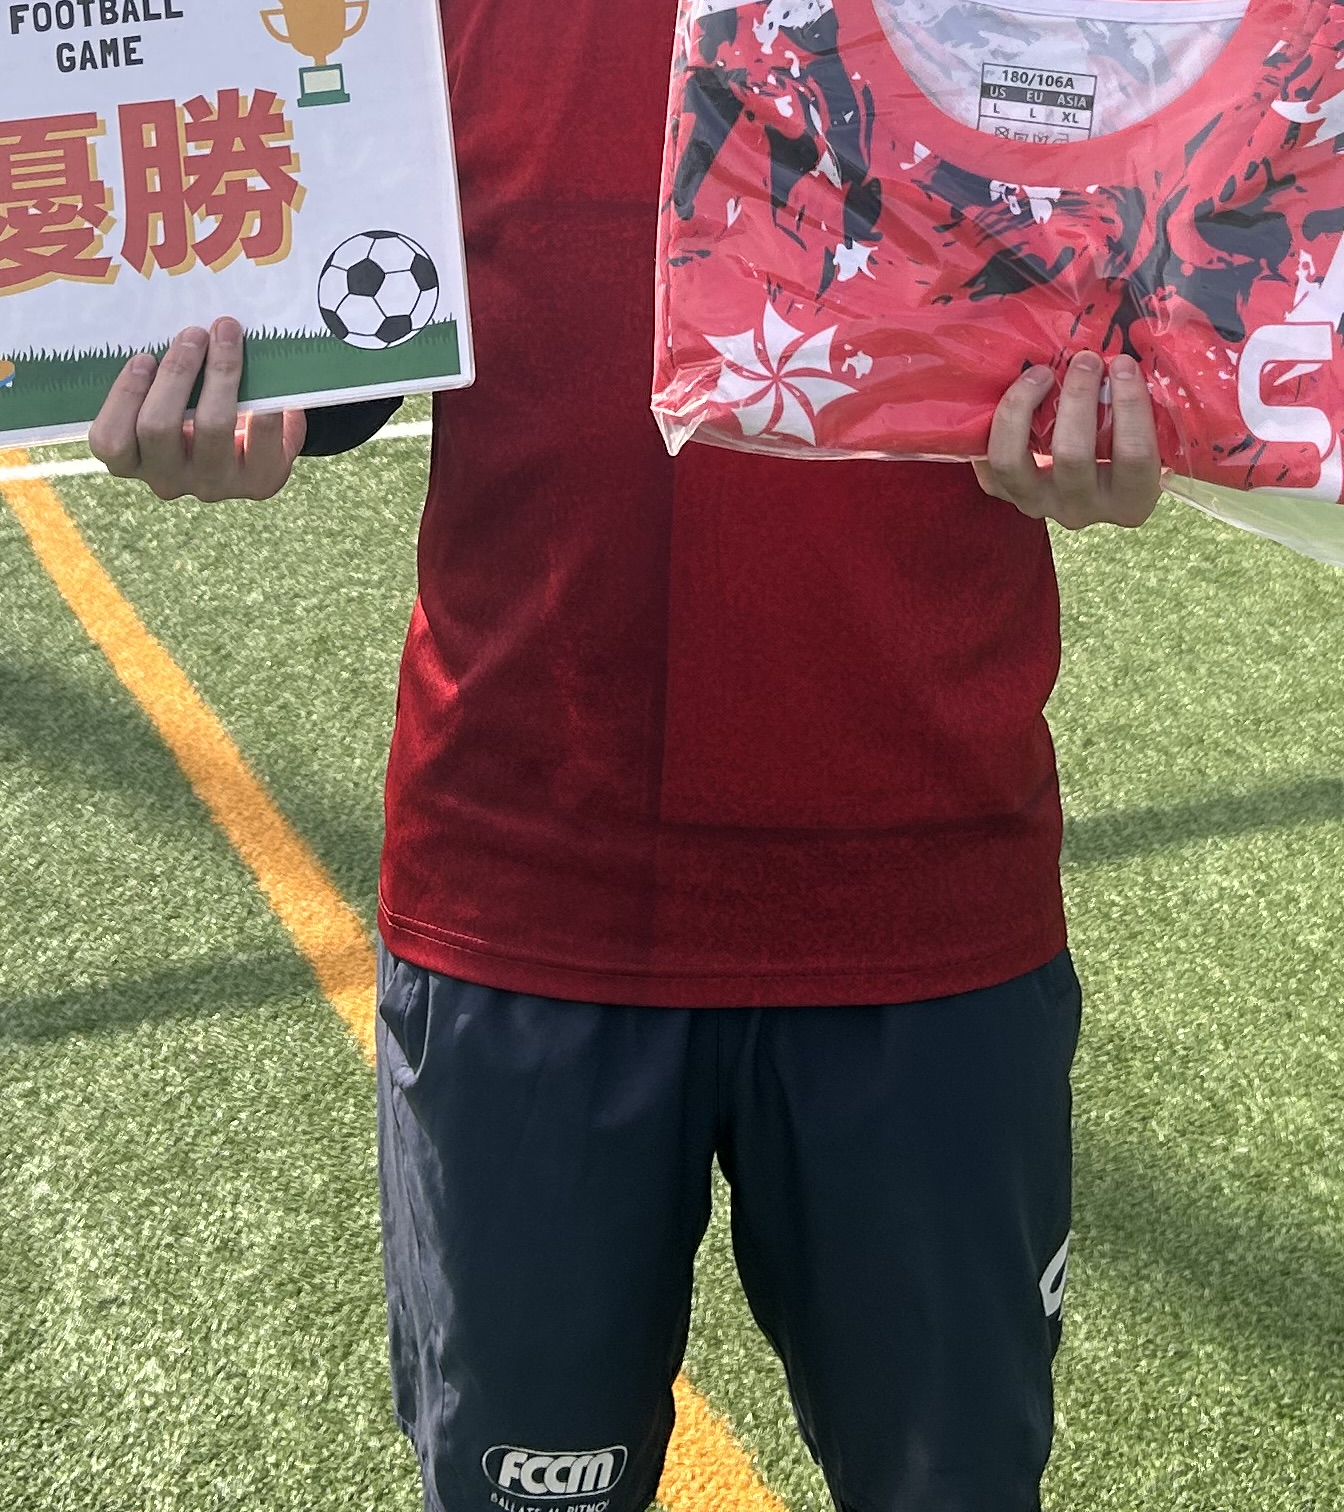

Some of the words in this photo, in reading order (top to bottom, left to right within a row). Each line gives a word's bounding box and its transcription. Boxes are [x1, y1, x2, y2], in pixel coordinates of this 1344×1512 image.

[55, 35, 144, 73] GAME
[1001, 70, 1075, 89] 180/106A
[989, 86, 1007, 98] US
[1026, 90, 1044, 102] EU
[1057, 94, 1087, 107] ASIA
[993, 103, 1000, 114] L
[1029, 108, 1036, 118] L
[1061, 111, 1079, 123] XL
